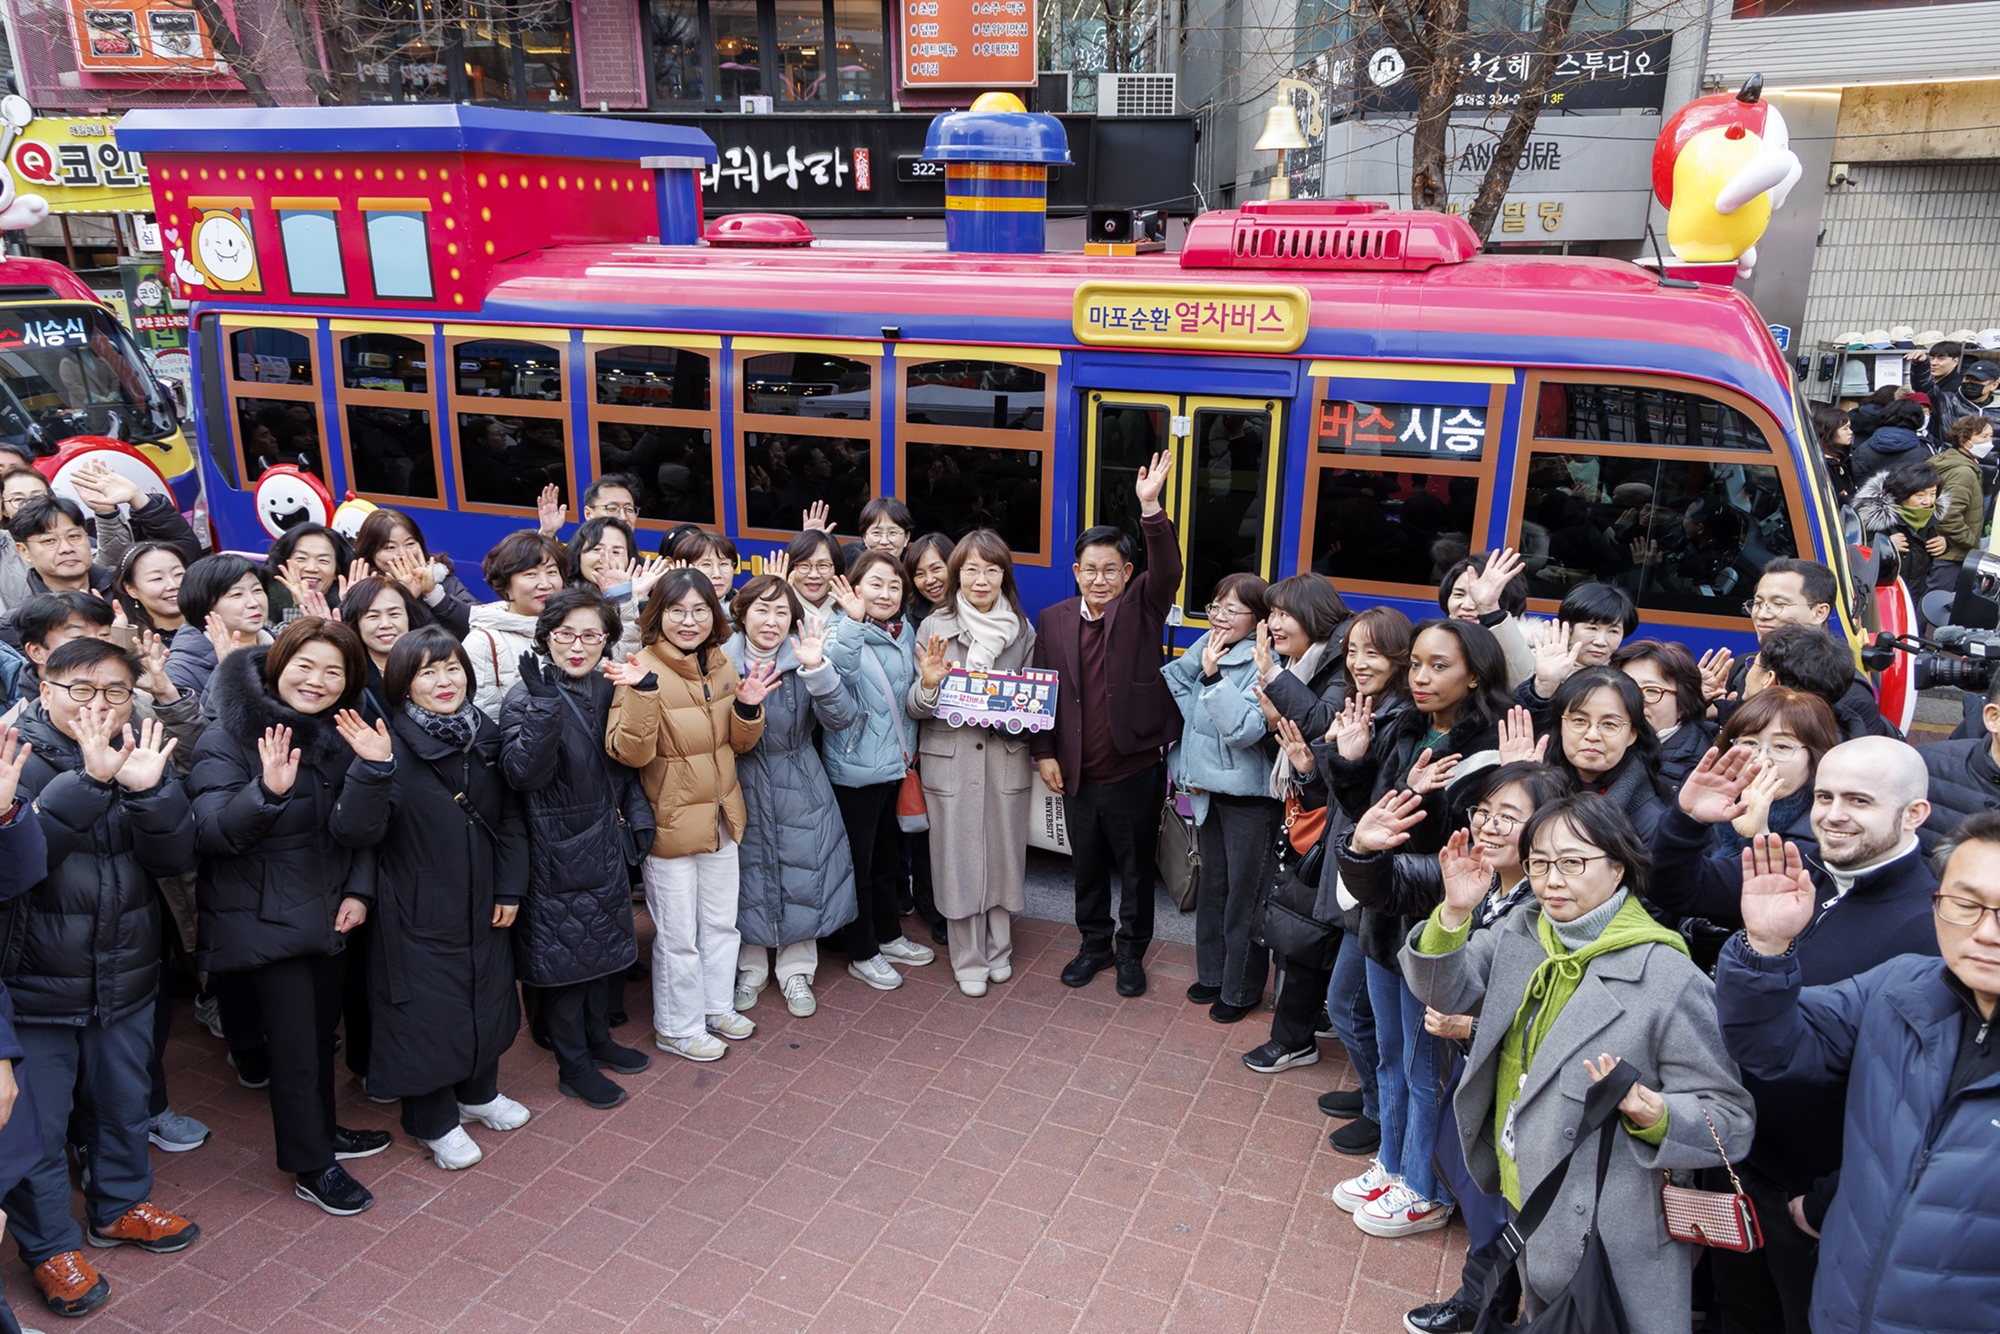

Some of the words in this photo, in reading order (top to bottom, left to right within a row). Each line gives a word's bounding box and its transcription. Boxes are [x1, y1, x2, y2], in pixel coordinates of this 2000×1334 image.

[981, 22, 1028, 36] 분위기맛집
[920, 43, 957, 57] 세트메뉴
[981, 42, 1019, 56] 홍대맛집
[920, 62, 939, 75] 튀김
[1550, 93, 1564, 104] 3F
[140, 286, 161, 300] 코인
[1089, 305, 1171, 332] 마포순환
[1174, 301, 1285, 334] 열차버스
[1055, 796, 1063, 822] SEOUL
[1045, 796, 1054, 839] UNIVERSITY
[1056, 823, 1065, 847] LEARN
